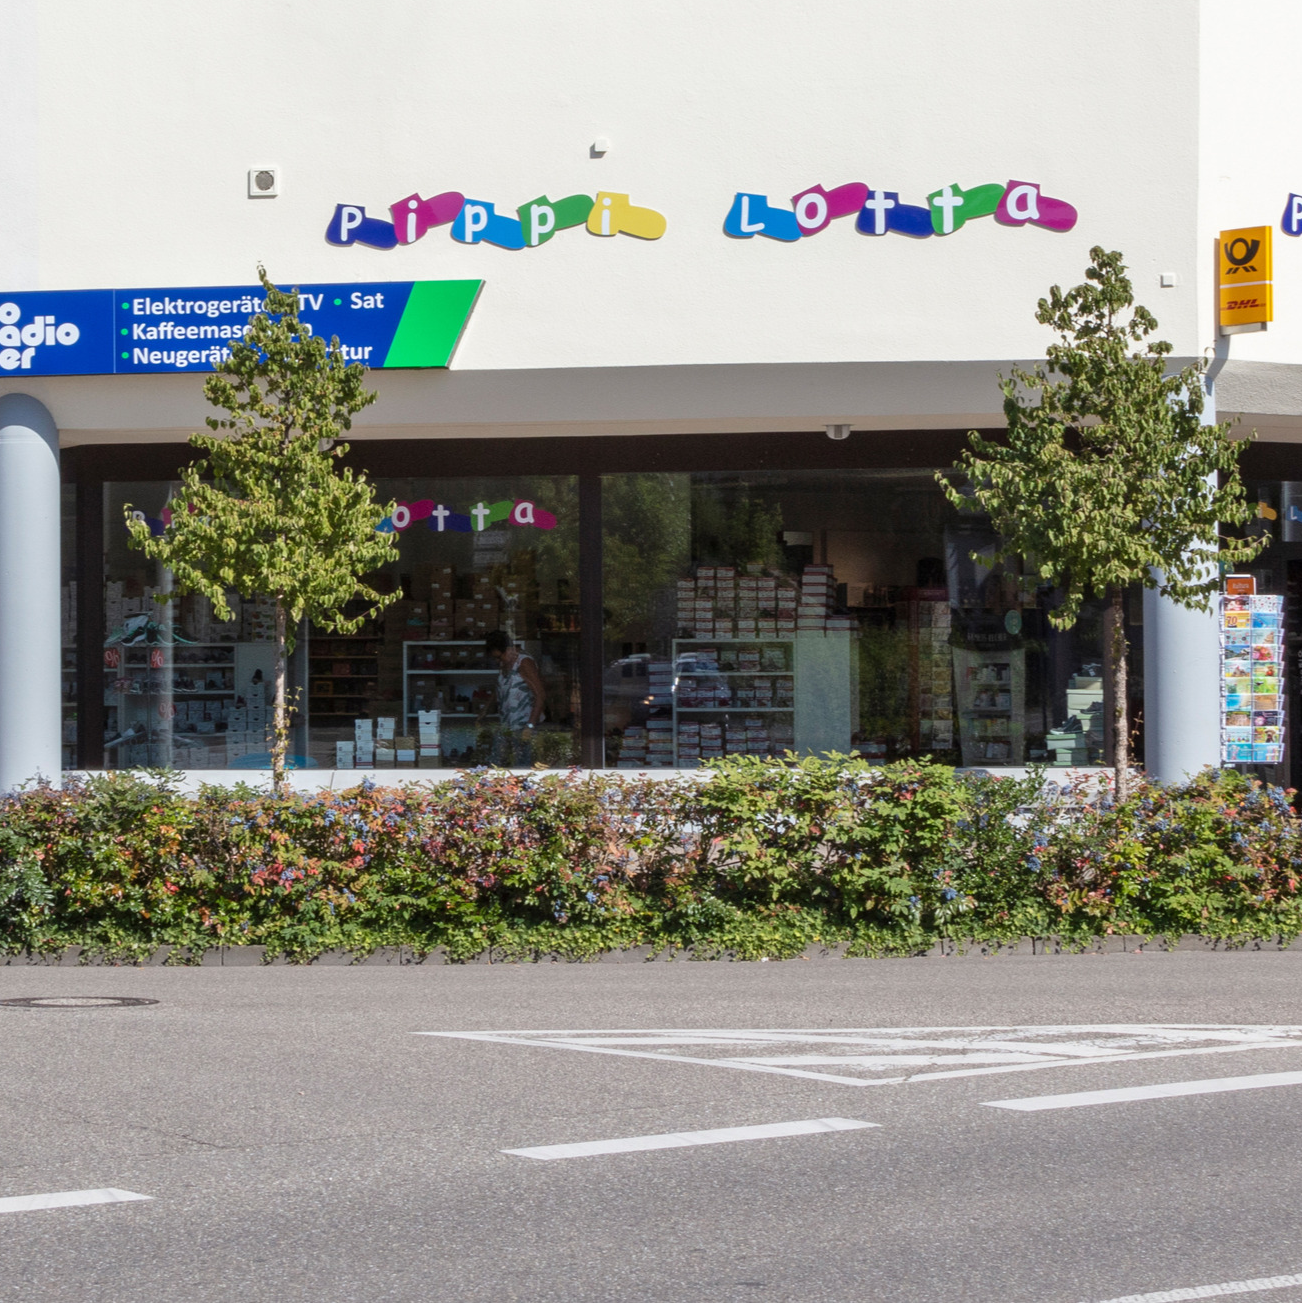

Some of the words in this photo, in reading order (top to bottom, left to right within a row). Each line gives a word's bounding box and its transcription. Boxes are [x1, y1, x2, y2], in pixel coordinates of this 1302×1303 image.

[339, 197, 613, 246] Pippi
[739, 182, 1042, 236] Lotta
[298, 293, 324, 310] TV
[351, 291, 384, 309] Sat
[1226, 298, 1259, 310] DHL
[133, 321, 313, 340] Kaffeemascn
[133, 345, 234, 368] Neugerät
[391, 500, 535, 532] otta
